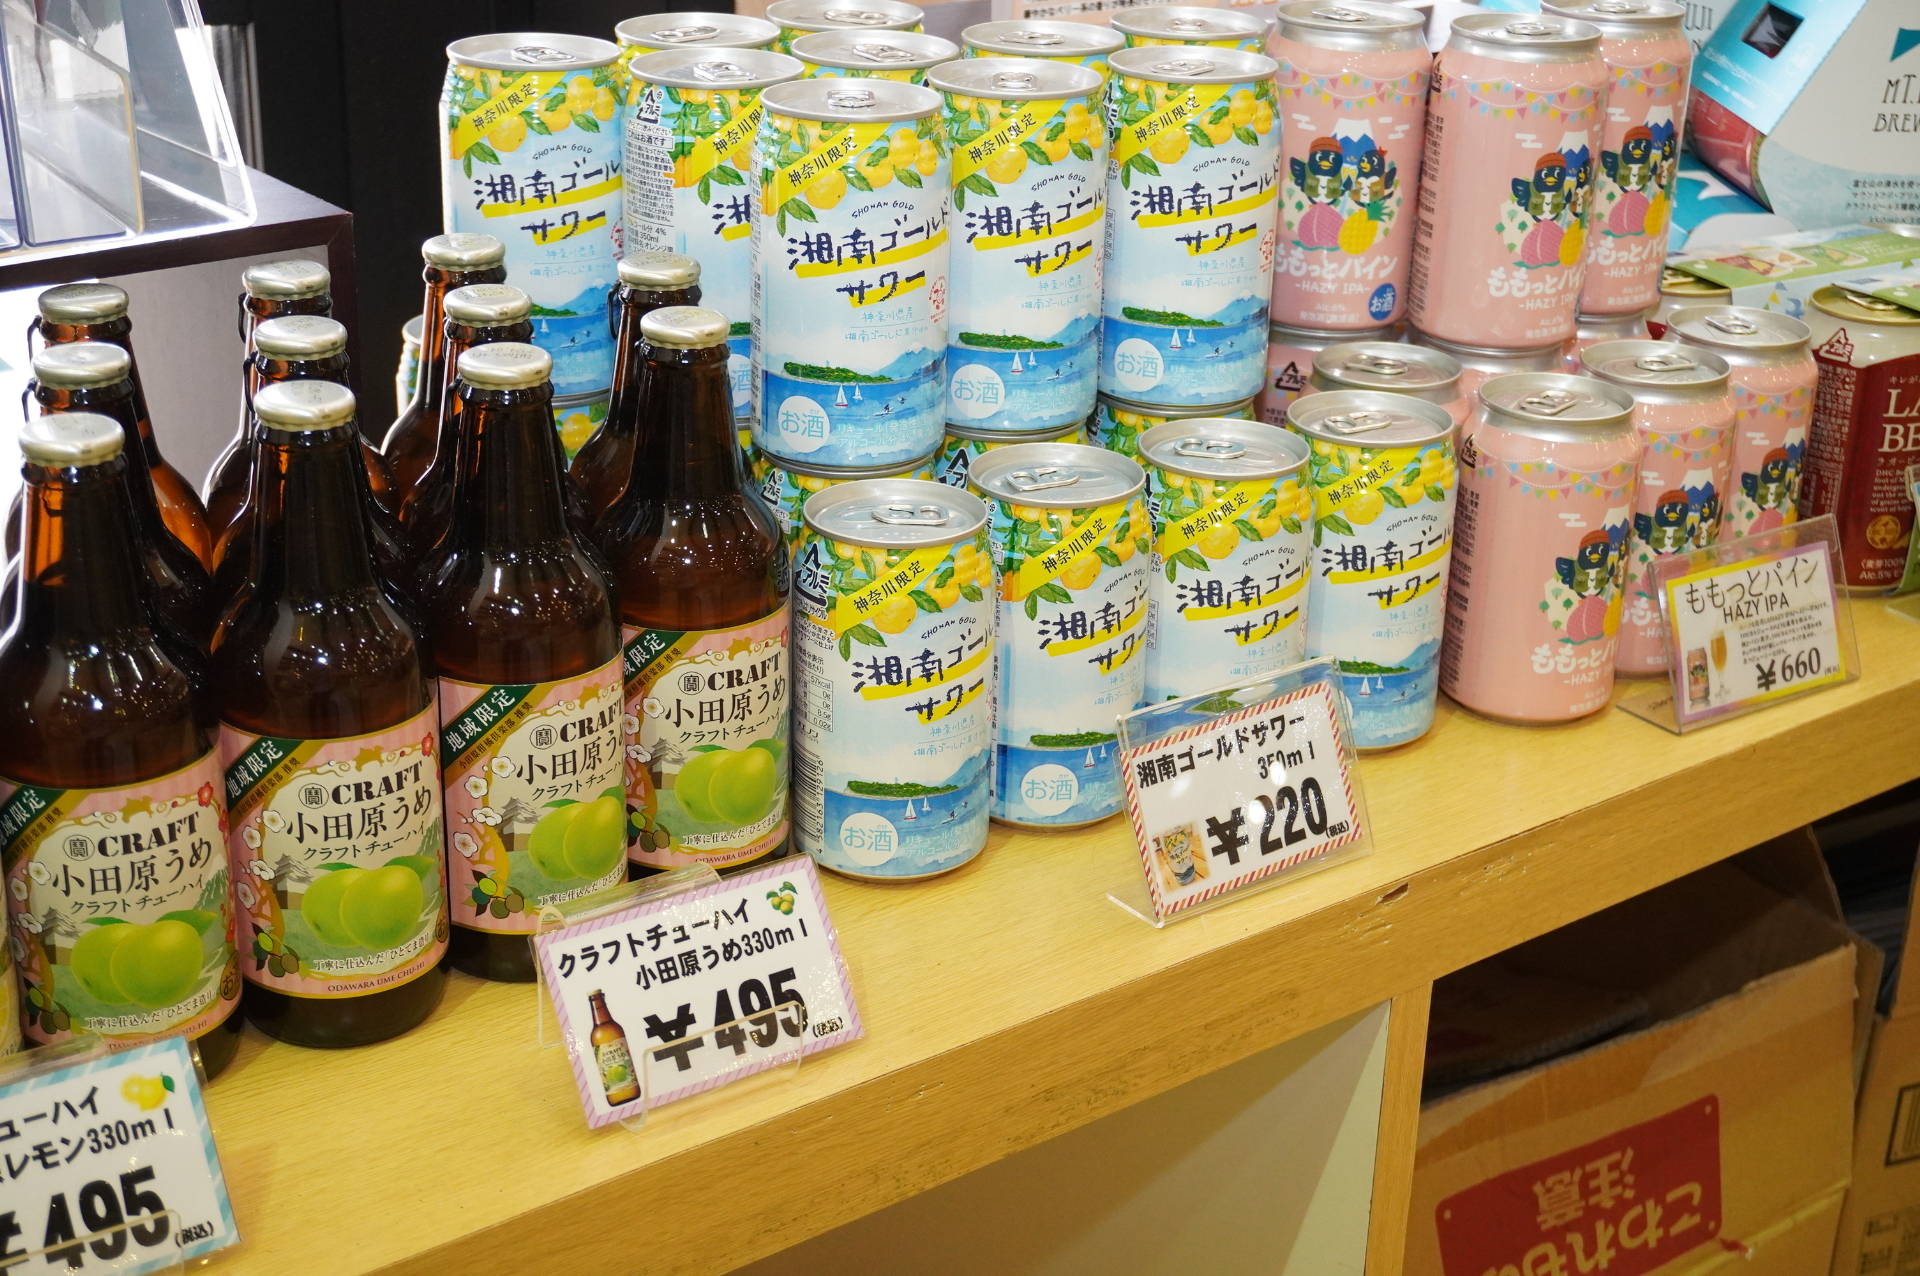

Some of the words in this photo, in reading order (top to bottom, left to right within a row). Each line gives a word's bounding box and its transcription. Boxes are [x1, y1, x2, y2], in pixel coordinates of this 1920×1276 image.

[472, 83, 536, 132] 神奈川限定
[1133, 96, 1201, 143] 神奈川限定
[571, 143, 593, 154] GOLD
[713, 105, 763, 155] 神奈川限
[968, 113, 1037, 164] 神奈川限定
[788, 136, 858, 188] 神奈川限定
[1067, 173, 1087, 183] GOLD
[1230, 156, 1251, 167] GOLD
[520, 210, 606, 242] サワー
[892, 200, 916, 212] GOLD
[640, 231, 659, 243] 350ml
[787, 196, 950, 271] 湘南ゴールド
[1174, 222, 1258, 253] サワー
[1014, 239, 1093, 275] サワー
[1274, 242, 1398, 280] ももっとパイン
[836, 270, 926, 305] サワー
[1116, 352, 1159, 379] お酒
[953, 379, 1000, 405] お酒
[781, 410, 825, 440] お酒
[1327, 459, 1394, 506] 神奈川限定
[1181, 491, 1250, 540] 神奈川限定
[1420, 513, 1438, 522] GOLD
[1042, 518, 1108, 574] 神奈川限定
[1277, 547, 1296, 555] GOLD
[853, 560, 925, 614] 神奈川限定
[1367, 571, 1441, 607] サワー
[1685, 556, 1819, 615] ももっとパイン
[958, 616, 977, 626] GOLD
[1224, 605, 1299, 643] サワー
[1722, 597, 1761, 624] HAZY
[1765, 592, 1790, 613] IPA
[707, 651, 781, 692] CRAFT
[810, 675, 831, 690] 57kcal
[1755, 647, 1821, 692] ¥660
[664, 674, 786, 729] 小田原うめ
[905, 677, 984, 721] サワー
[446, 689, 516, 753] 地域限定
[678, 706, 781, 745] クラフトチューハイ
[458, 716, 517, 770] 小田原柑橘倶楽部
[1136, 714, 1305, 789] 湘南ゴールドサワー
[226, 740, 284, 799] 地域限定
[331, 760, 423, 806] CRAFT
[1024, 778, 1073, 801] お酒
[97, 811, 200, 858] CRAFT
[286, 785, 432, 844] 小田原うめ
[1206, 776, 1328, 867] ¥220
[1326, 820, 1350, 839] (税込)
[303, 820, 426, 861] クラフトチューハイ
[695, 851, 737, 865] ODAWARA
[736, 847, 755, 859] UME
[843, 826, 893, 853] お酒
[52, 837, 213, 898] 小田原うめ
[70, 873, 204, 916] クラフトチューハイ
[558, 898, 751, 979] クラフトチューハイ
[327, 981, 376, 993] ODAWARA
[376, 974, 397, 987] UME
[397, 960, 426, 982] CHU-HI
[642, 967, 809, 1073] ¥495
[812, 1016, 846, 1039] (税込)
[0, 1107, 175, 1183] レモン330ml
[1532, 1147, 1635, 1231] 注意
[175, 1220, 215, 1249] (税込)
